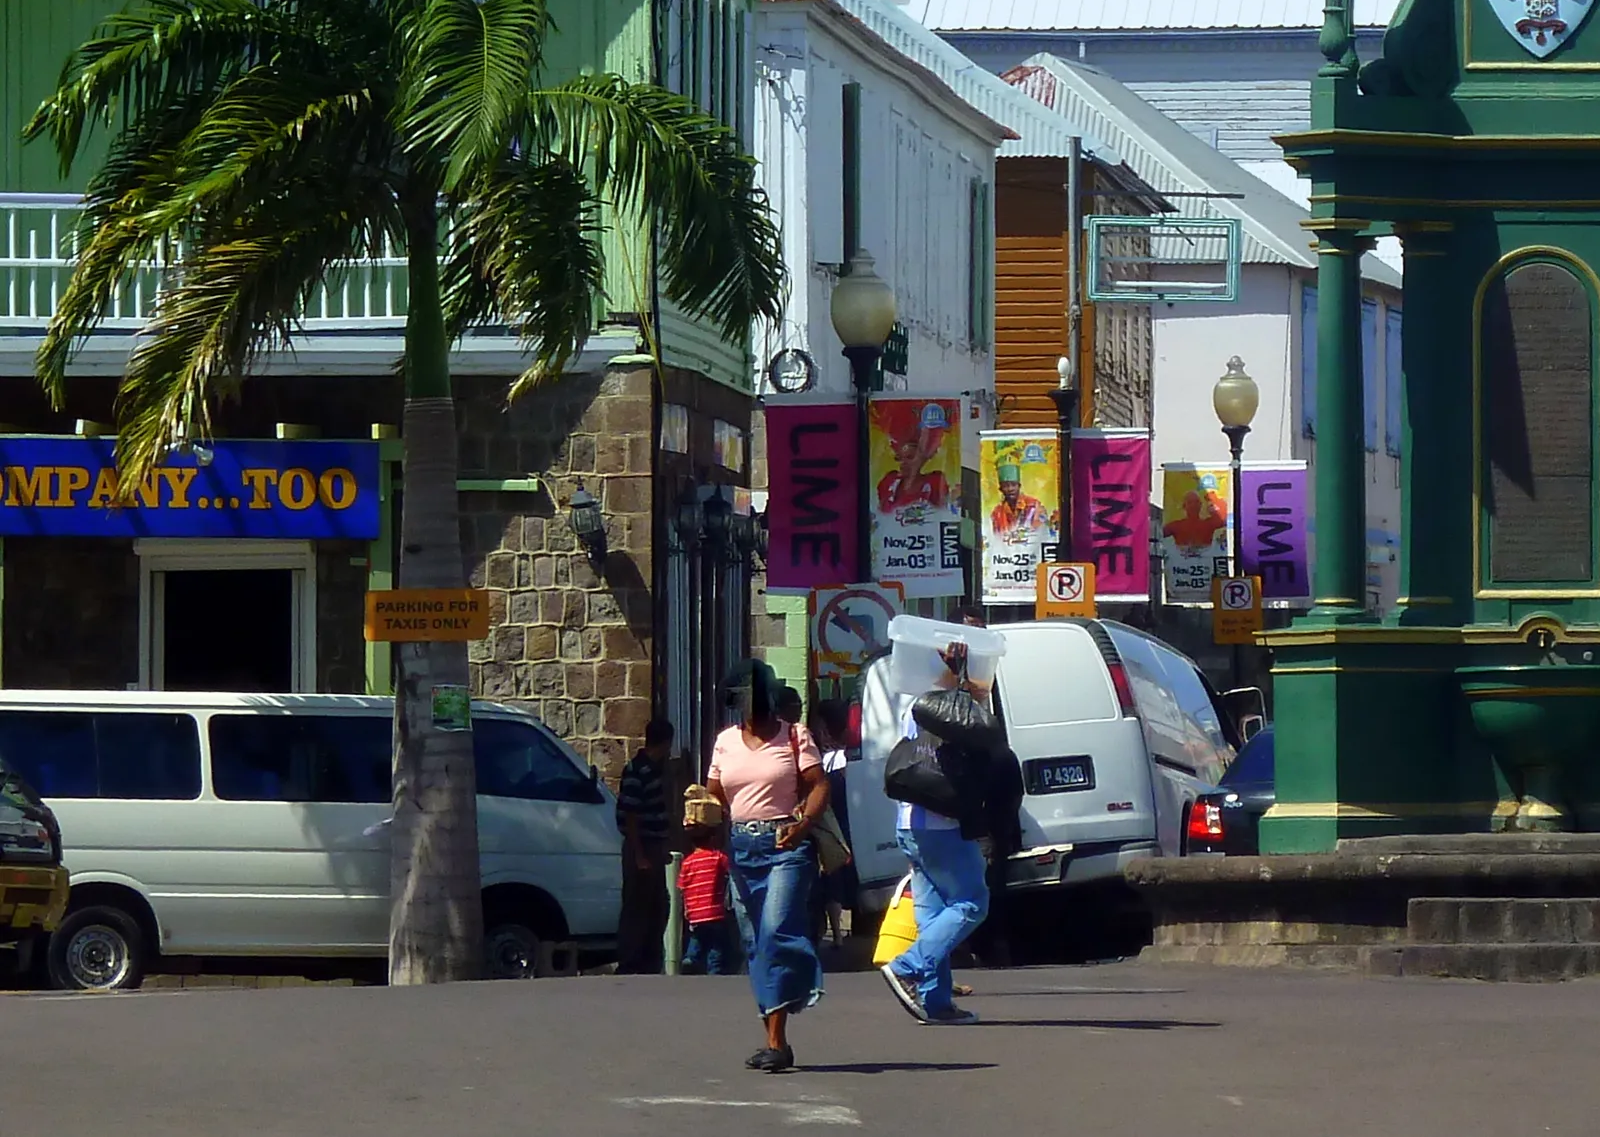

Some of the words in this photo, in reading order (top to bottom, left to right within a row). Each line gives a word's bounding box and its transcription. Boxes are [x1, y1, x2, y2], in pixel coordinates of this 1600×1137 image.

[790, 422, 840, 569] LIME
[1091, 453, 1134, 576] LIME
[943, 525, 959, 566] LIME
[1257, 482, 1295, 584] LIME
[376, 601, 444, 612] PARKING
[449, 600, 479, 612] FOR
[384, 619, 427, 630] TAXIS
[432, 618, 471, 630] ONLY
[1044, 768, 1052, 785] P
